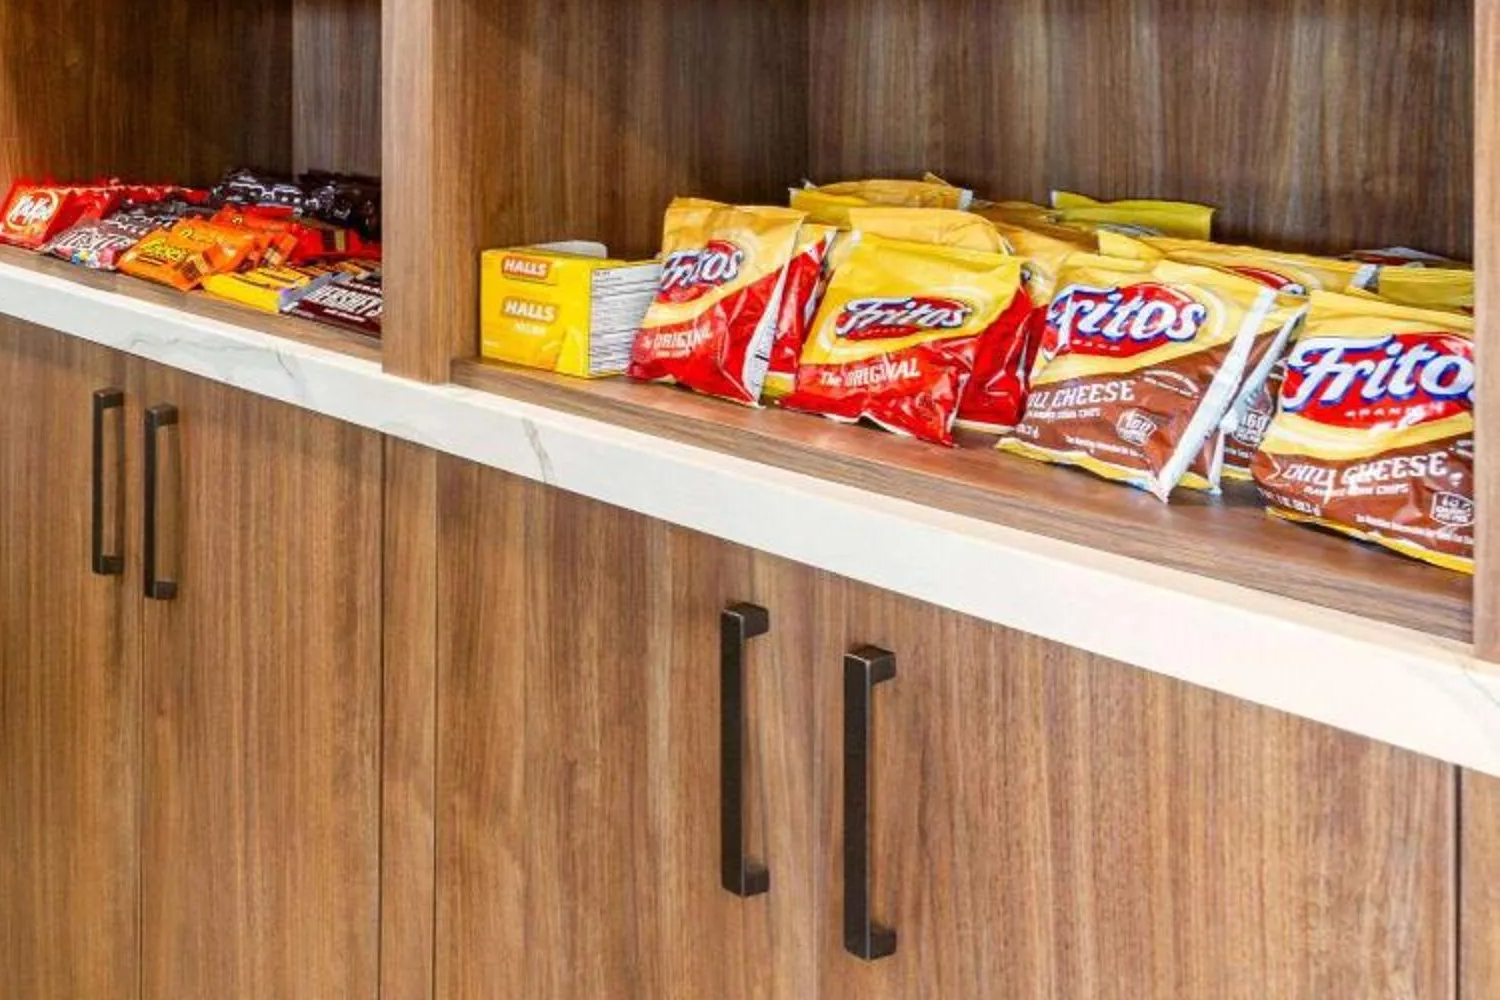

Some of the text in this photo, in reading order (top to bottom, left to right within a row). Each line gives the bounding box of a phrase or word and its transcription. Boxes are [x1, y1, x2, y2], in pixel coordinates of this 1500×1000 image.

[503, 257, 547, 277] HALLS
[661, 249, 744, 292] Fritos
[504, 301, 556, 322] HALLS
[838, 296, 971, 338] Fritos
[1047, 283, 1207, 360] Fritos
[847, 357, 921, 387] ORIGINAL
[1285, 335, 1476, 413] Frito
[1051, 380, 1137, 409] CHEESE
[1341, 451, 1449, 486] CHEESE
